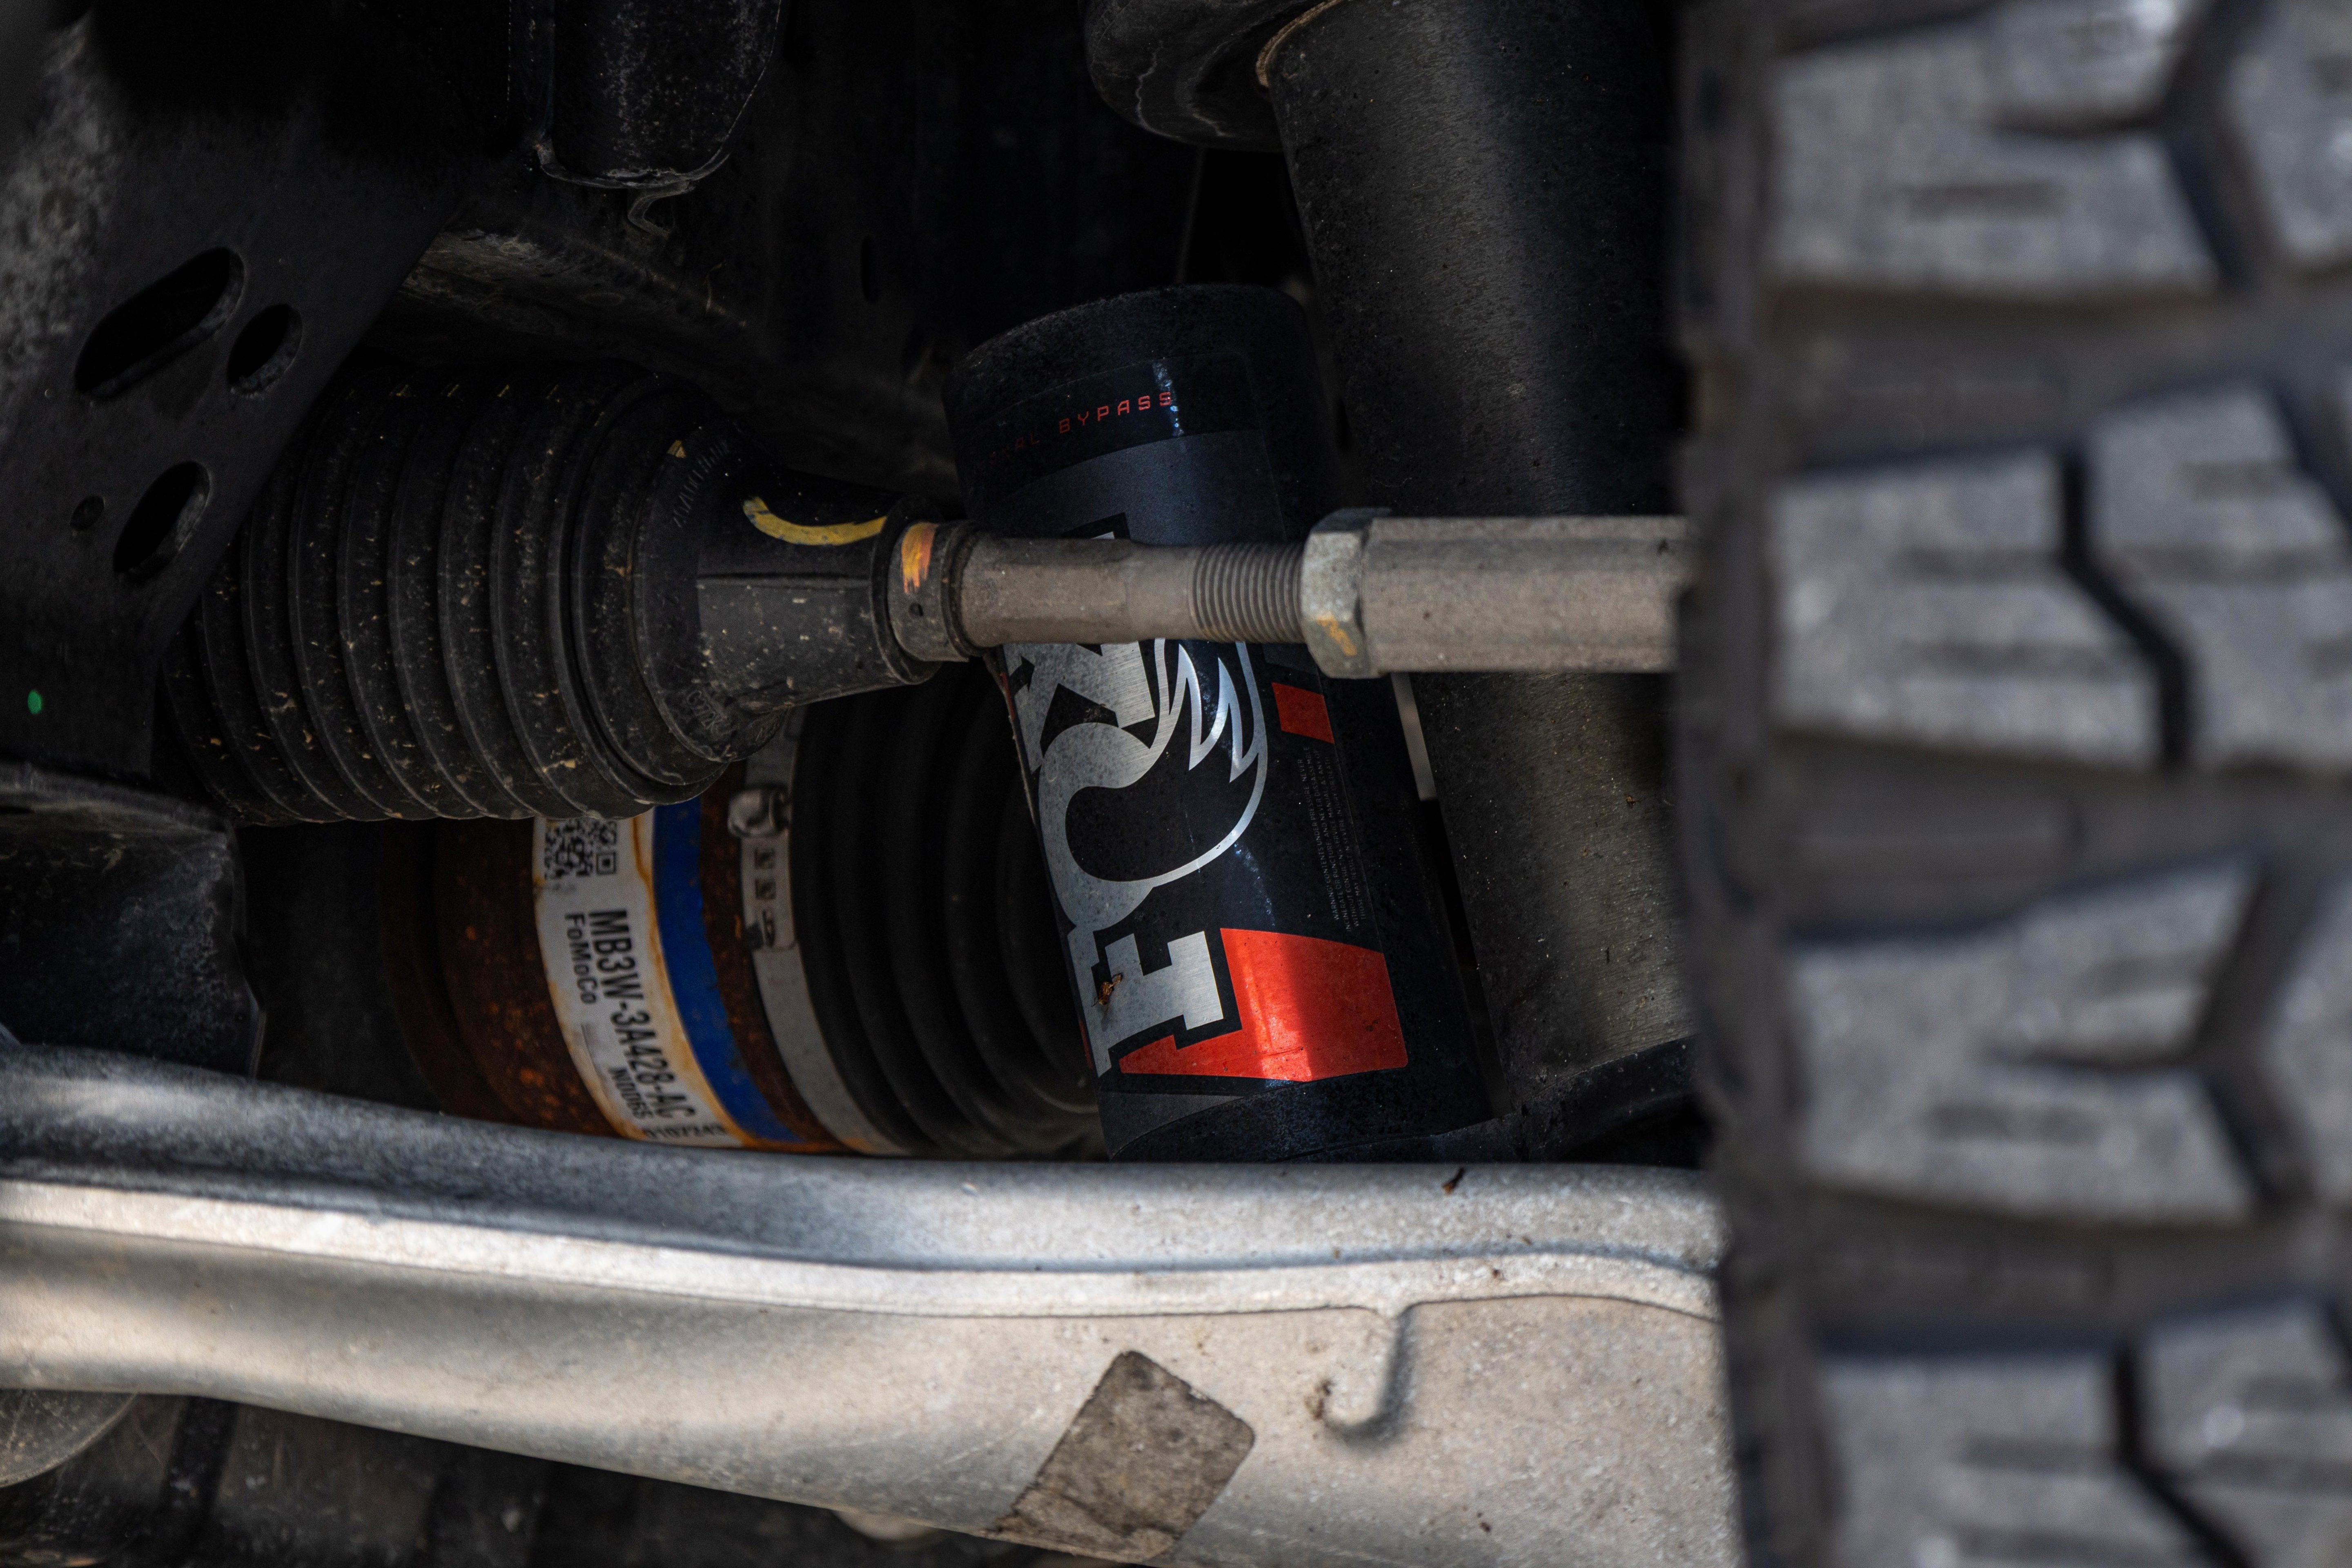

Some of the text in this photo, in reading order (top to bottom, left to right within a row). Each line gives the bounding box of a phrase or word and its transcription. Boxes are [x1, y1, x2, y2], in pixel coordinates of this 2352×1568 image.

[1059, 391, 1172, 434] BYPASS
[1311, 821, 1322, 846] UNDER
[1317, 846, 1331, 884] CONTENTS
[565, 913, 597, 1004] FoMoCo
[589, 908, 696, 1118] MB3W-3A428-AC
